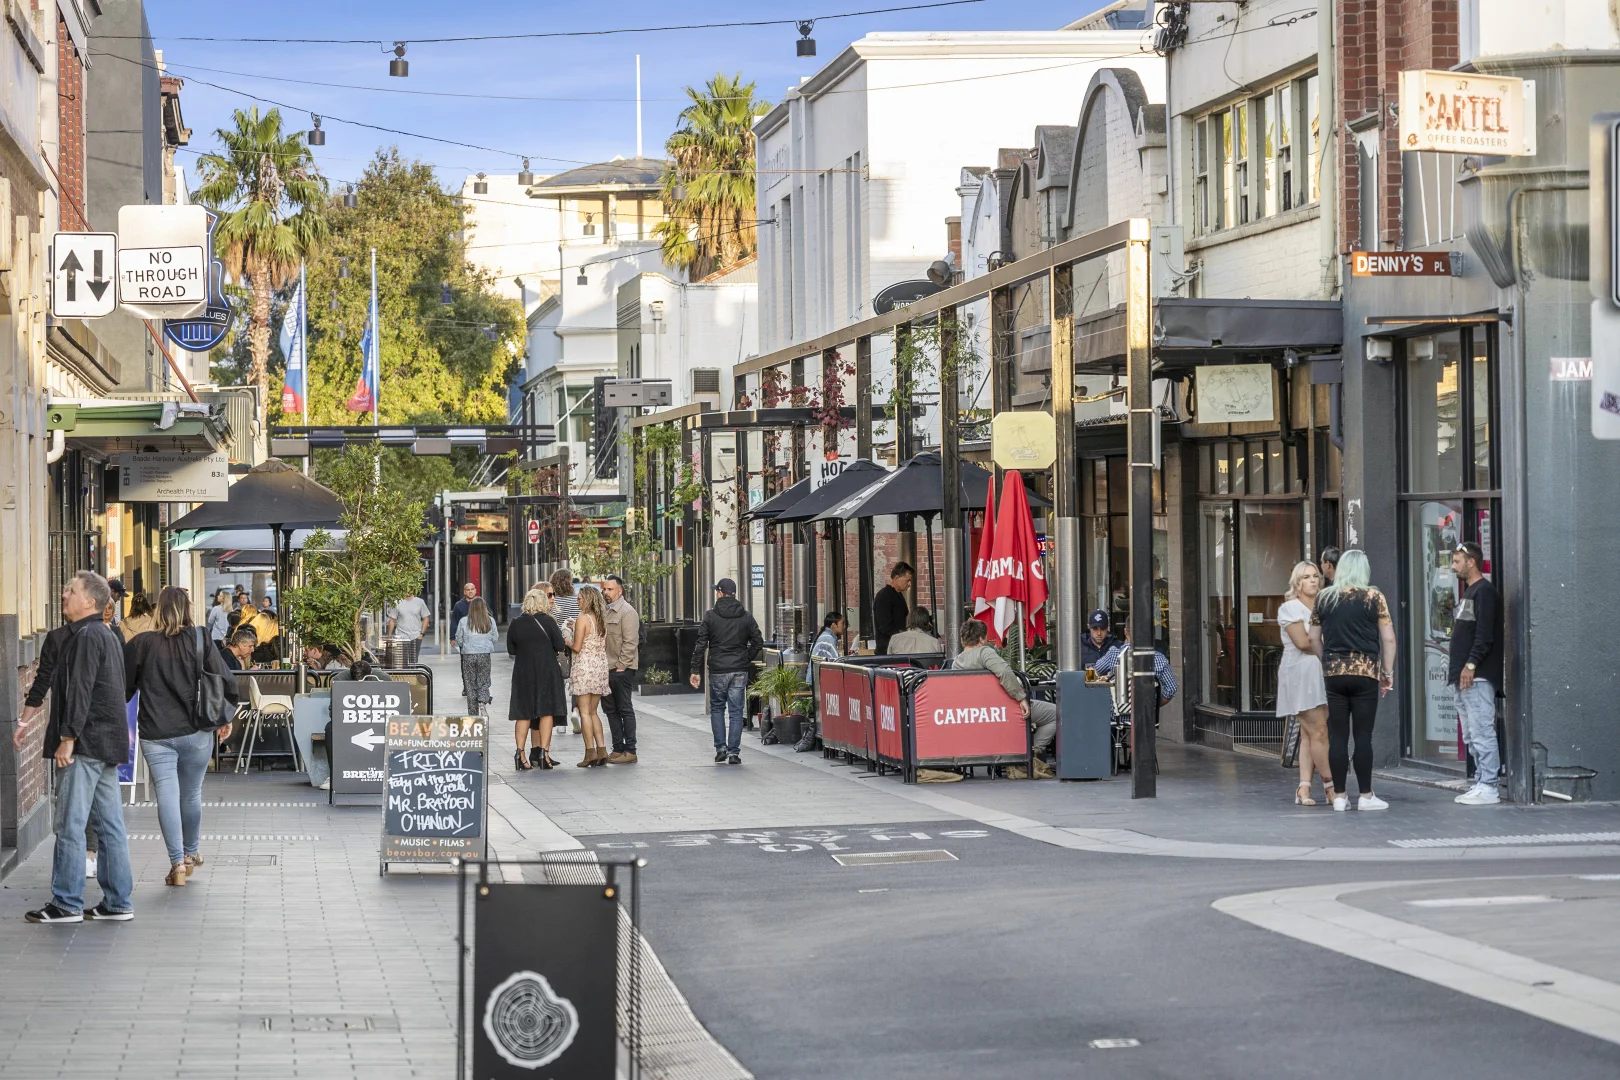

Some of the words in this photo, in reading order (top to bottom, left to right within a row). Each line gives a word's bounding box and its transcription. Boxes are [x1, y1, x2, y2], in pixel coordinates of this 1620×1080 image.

[1427, 133, 1457, 144] OFFEE
[1460, 136, 1508, 147] ROASTERS
[149, 251, 172, 264] NO
[1356, 253, 1424, 273] DENNY'S
[1434, 261, 1445, 272] PL
[126, 267, 198, 282] THROUGH
[139, 285, 186, 298] ROAD
[821, 460, 847, 478] HOT
[342, 694, 401, 709] COLD
[933, 706, 1007, 726] CAMPARI
[389, 721, 448, 737] BEAV'S
[449, 724, 484, 738] BAR
[388, 738, 403, 747] BAR
[407, 740, 451, 748] FUNCTIONS
[455, 740, 483, 748] COFFEE
[400, 838, 431, 847] MUSIC
[439, 839, 465, 848] FILMS
[386, 847, 479, 859] beavsbar.comau
